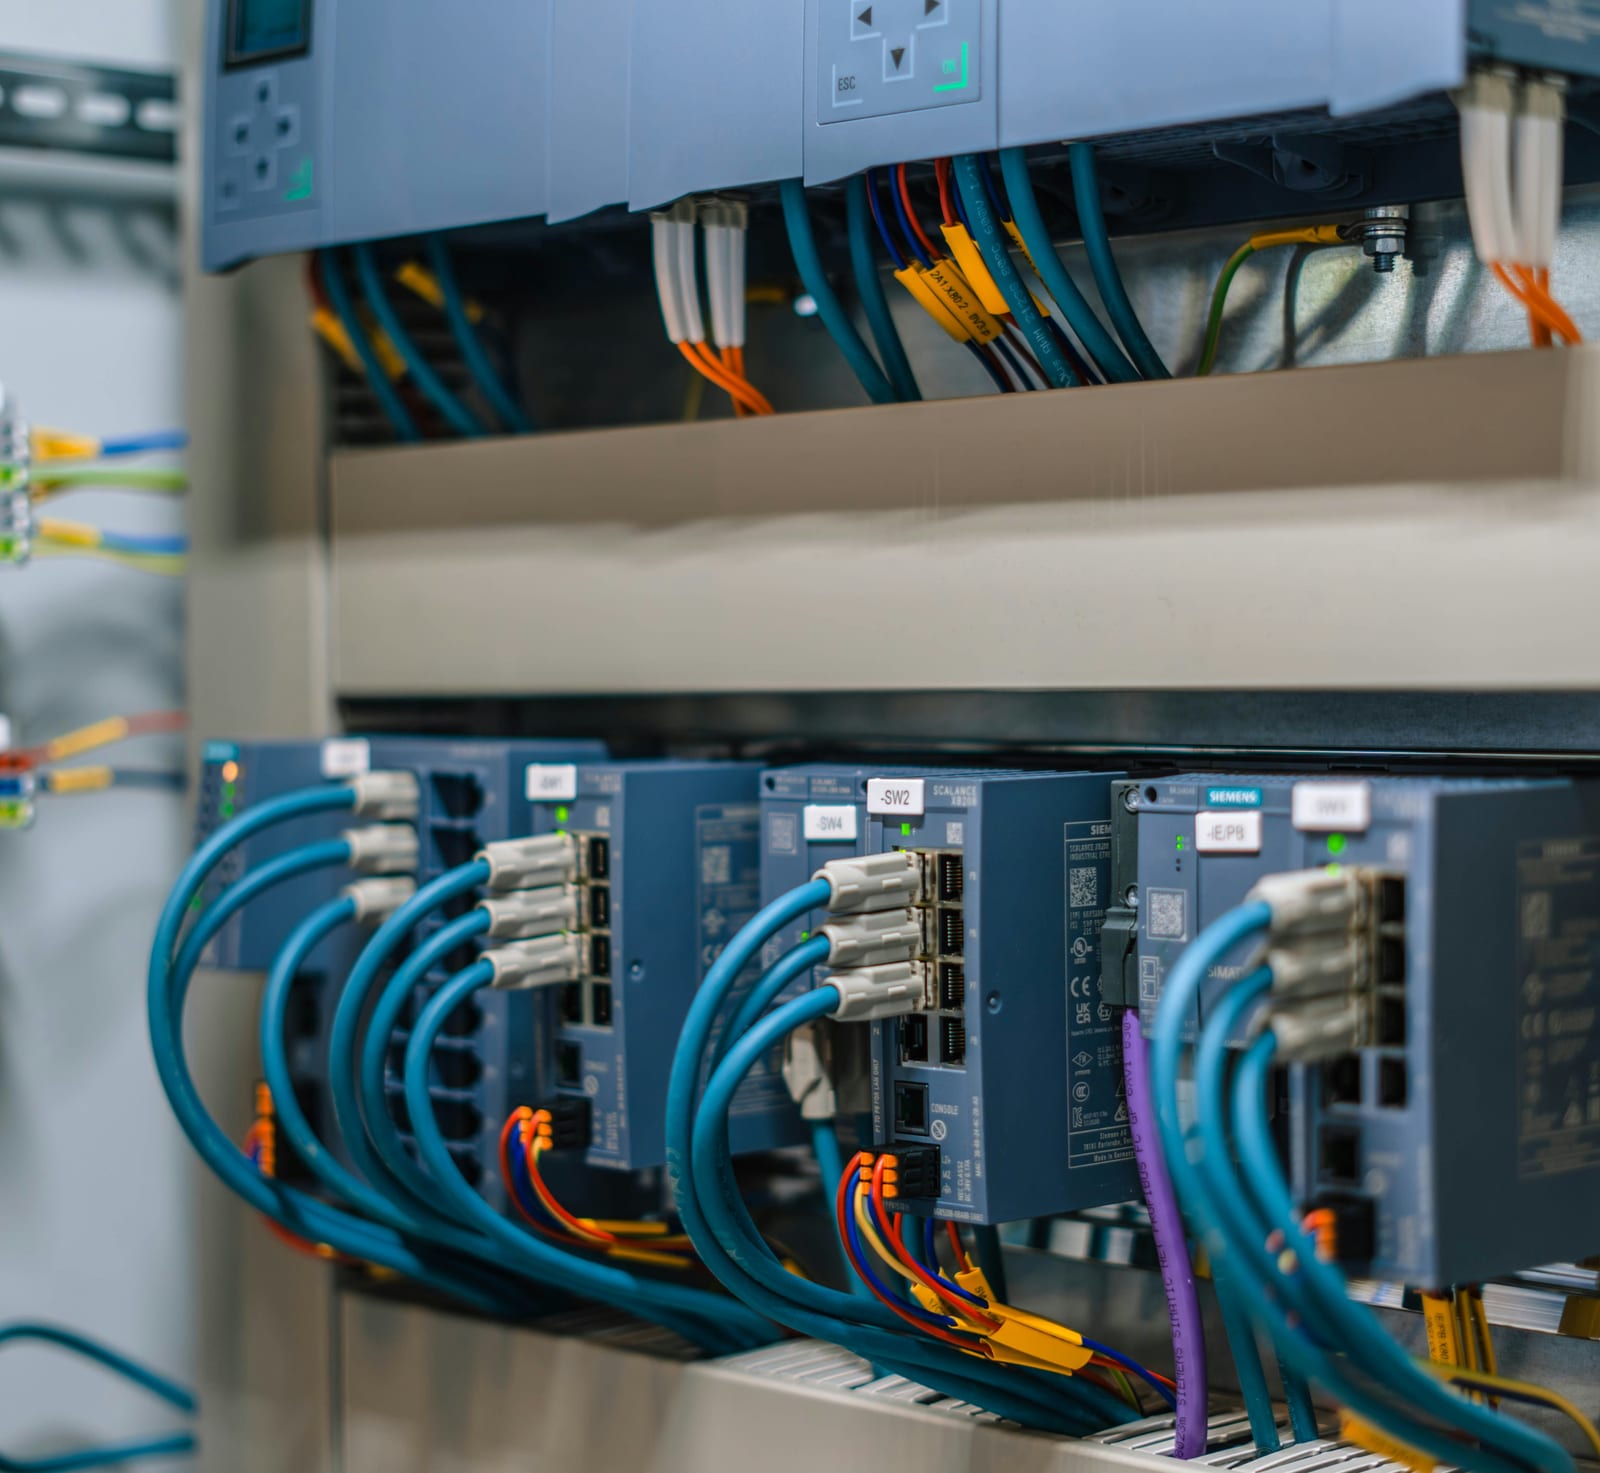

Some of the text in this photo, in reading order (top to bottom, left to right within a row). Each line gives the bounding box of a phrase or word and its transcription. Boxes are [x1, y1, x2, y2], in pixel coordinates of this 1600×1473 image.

[838, 76, 856, 91] ESC
[880, 789, 910, 806] -SW2
[933, 785, 977, 797] SCALANCE
[1210, 791, 1258, 803] SIEMENS
[816, 815, 843, 831] -SW4
[931, 1102, 959, 1115] CONSOLE
[1165, 1276, 1181, 1338] SIMATIC
[1175, 1347, 1187, 1406] SIEMENS
